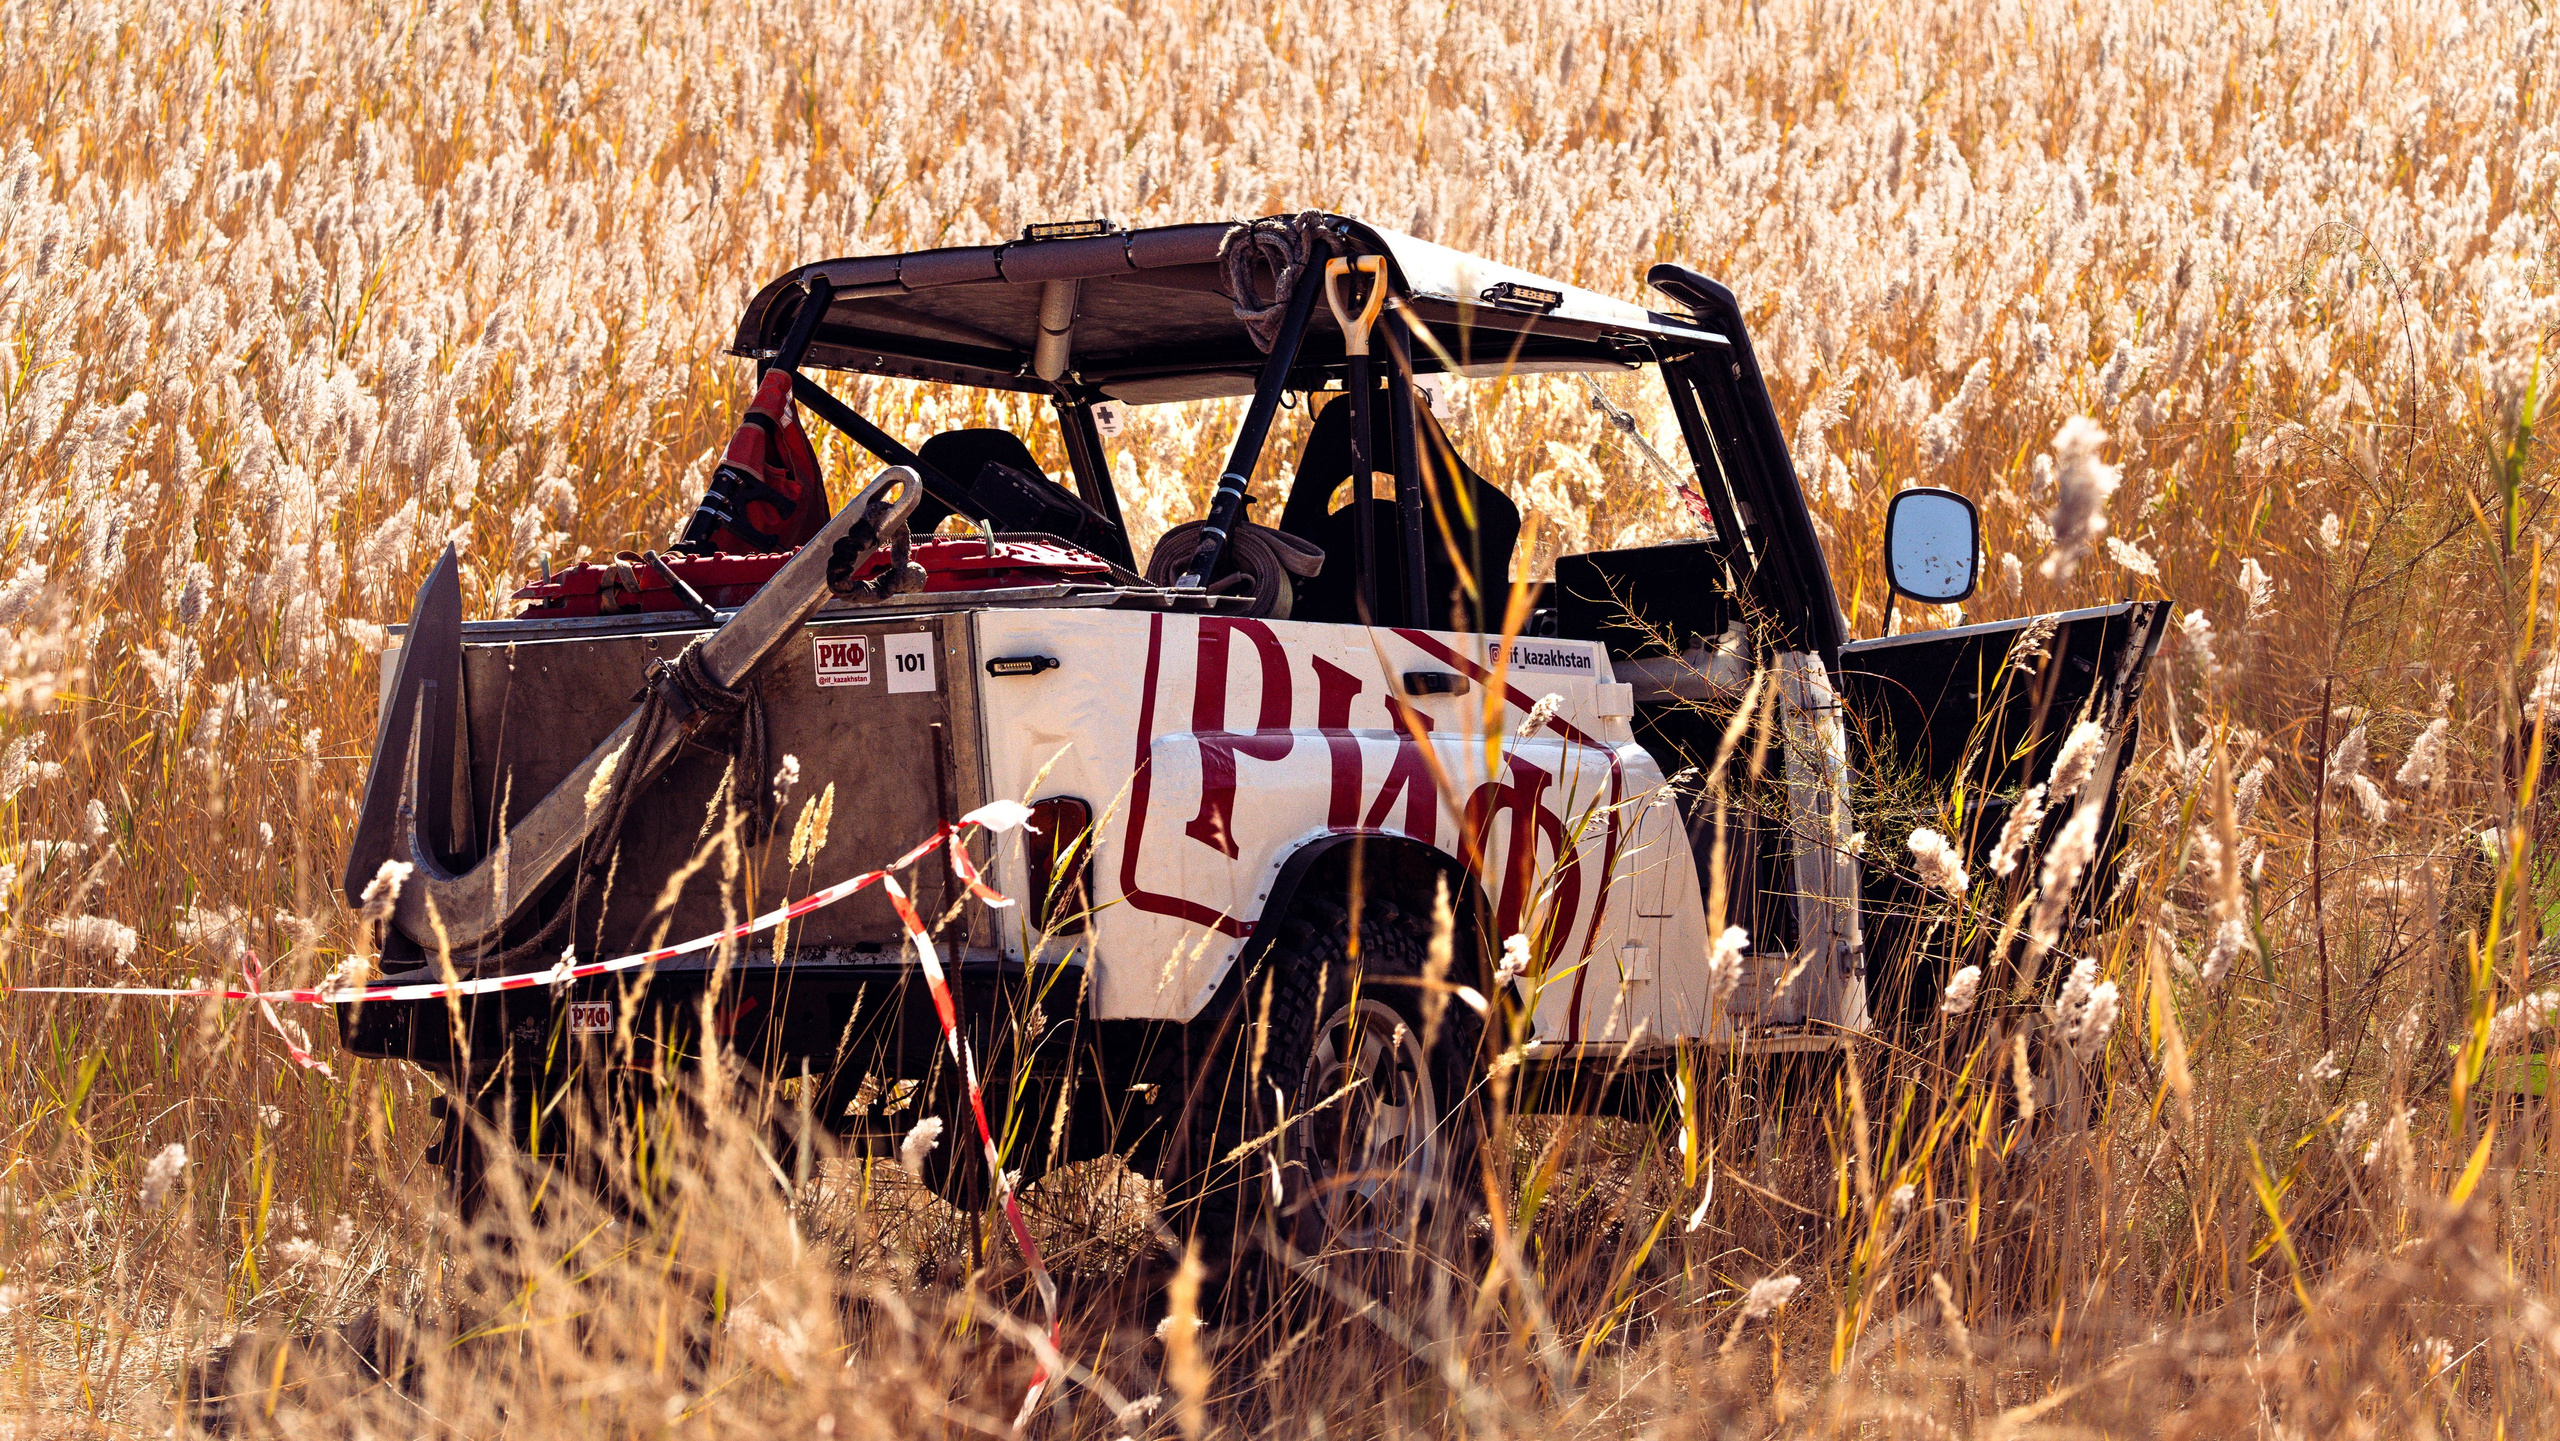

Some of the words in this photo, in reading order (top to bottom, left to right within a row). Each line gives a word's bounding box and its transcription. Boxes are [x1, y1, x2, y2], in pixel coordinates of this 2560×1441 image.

[818, 643, 865, 667] РИФ
[895, 653, 925, 672] 101
[1506, 646, 1591, 669] if_kazakhstan
[818, 676, 867, 684] @rif_kazakhstan
[1185, 616, 1582, 978] РИФ
[572, 1007, 610, 1028] РИФ
